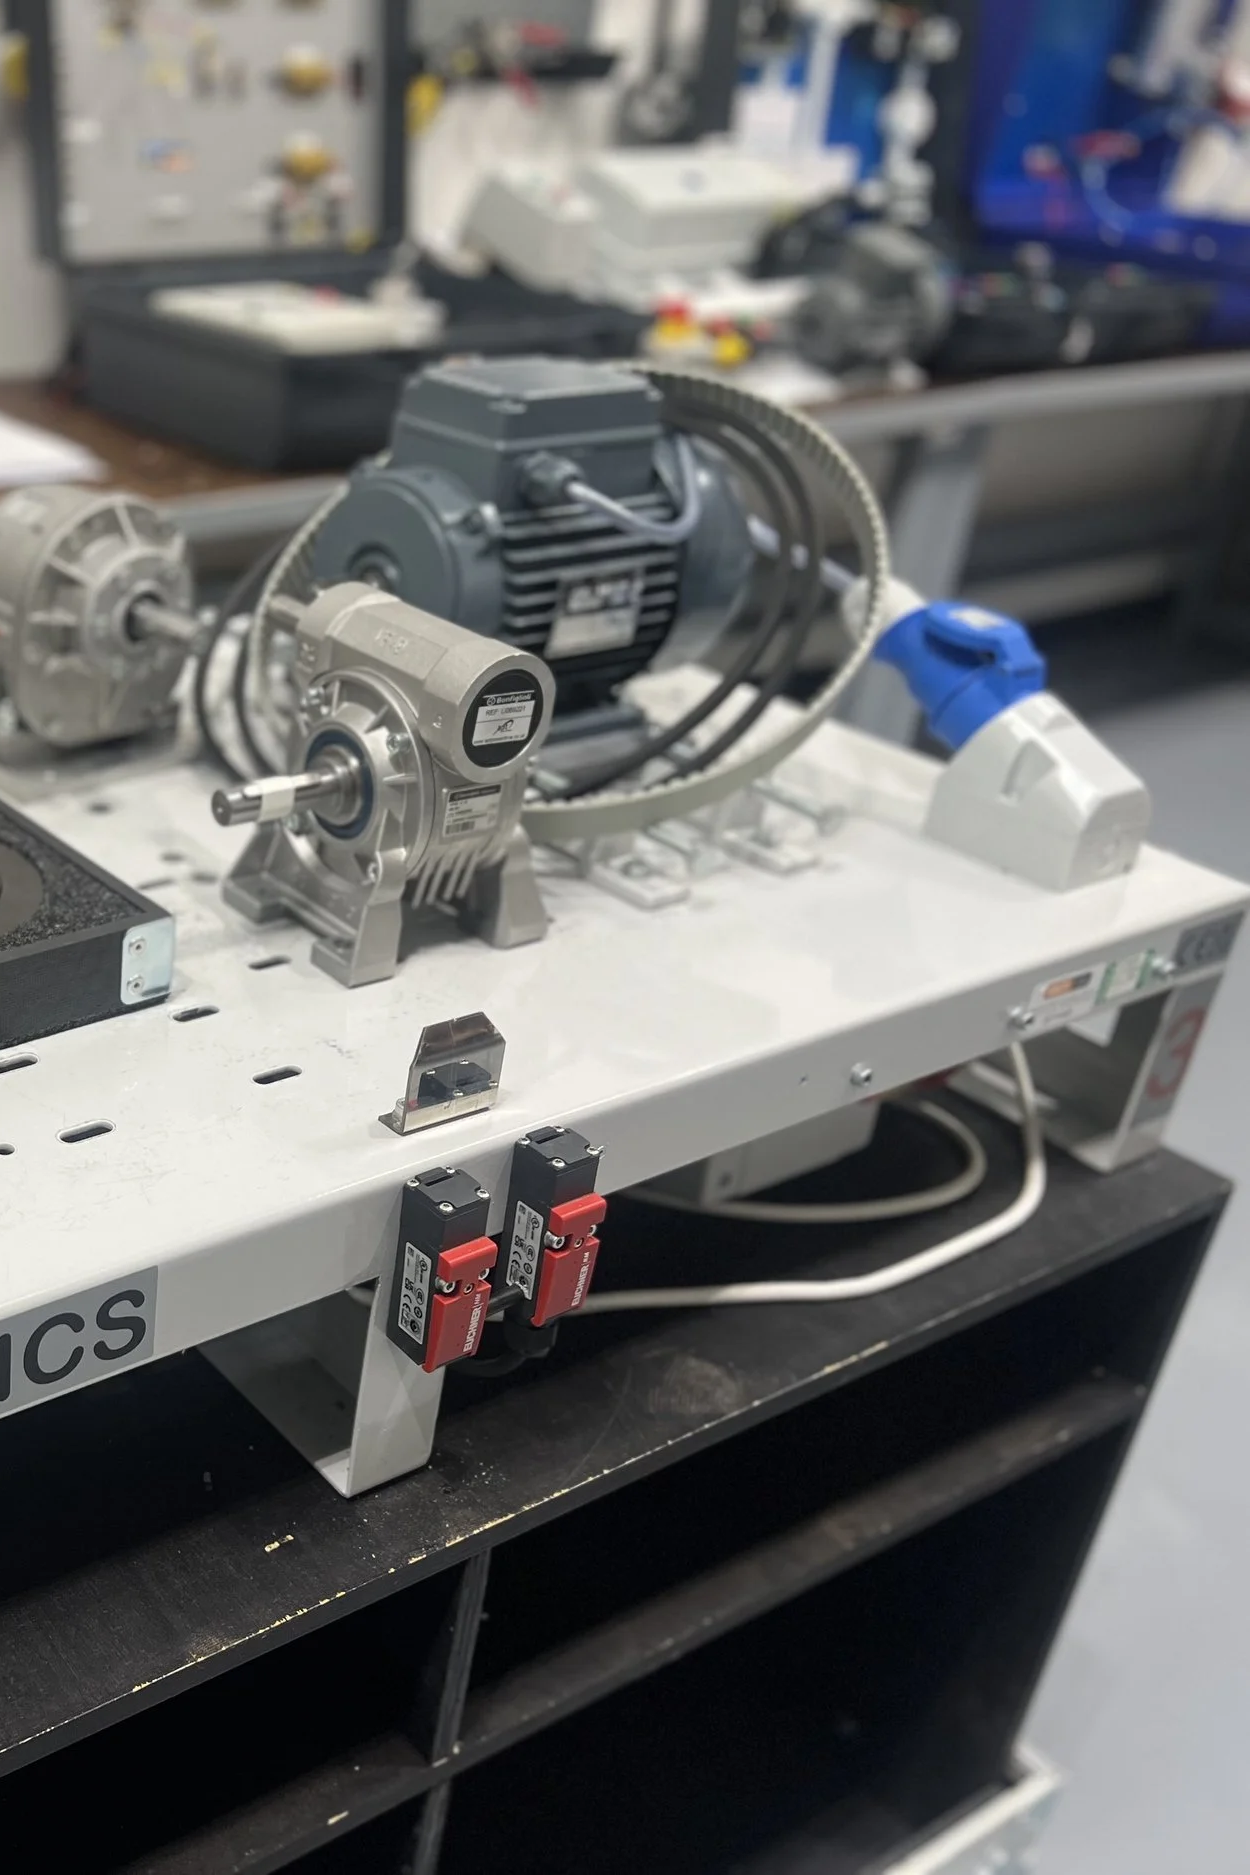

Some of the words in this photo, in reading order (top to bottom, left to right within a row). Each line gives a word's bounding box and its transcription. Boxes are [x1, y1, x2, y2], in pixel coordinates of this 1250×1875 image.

[1147, 1005, 1207, 1098] 3
[571, 1264, 589, 1306] EUCHNER
[463, 1306, 482, 1352] EUCHNER
